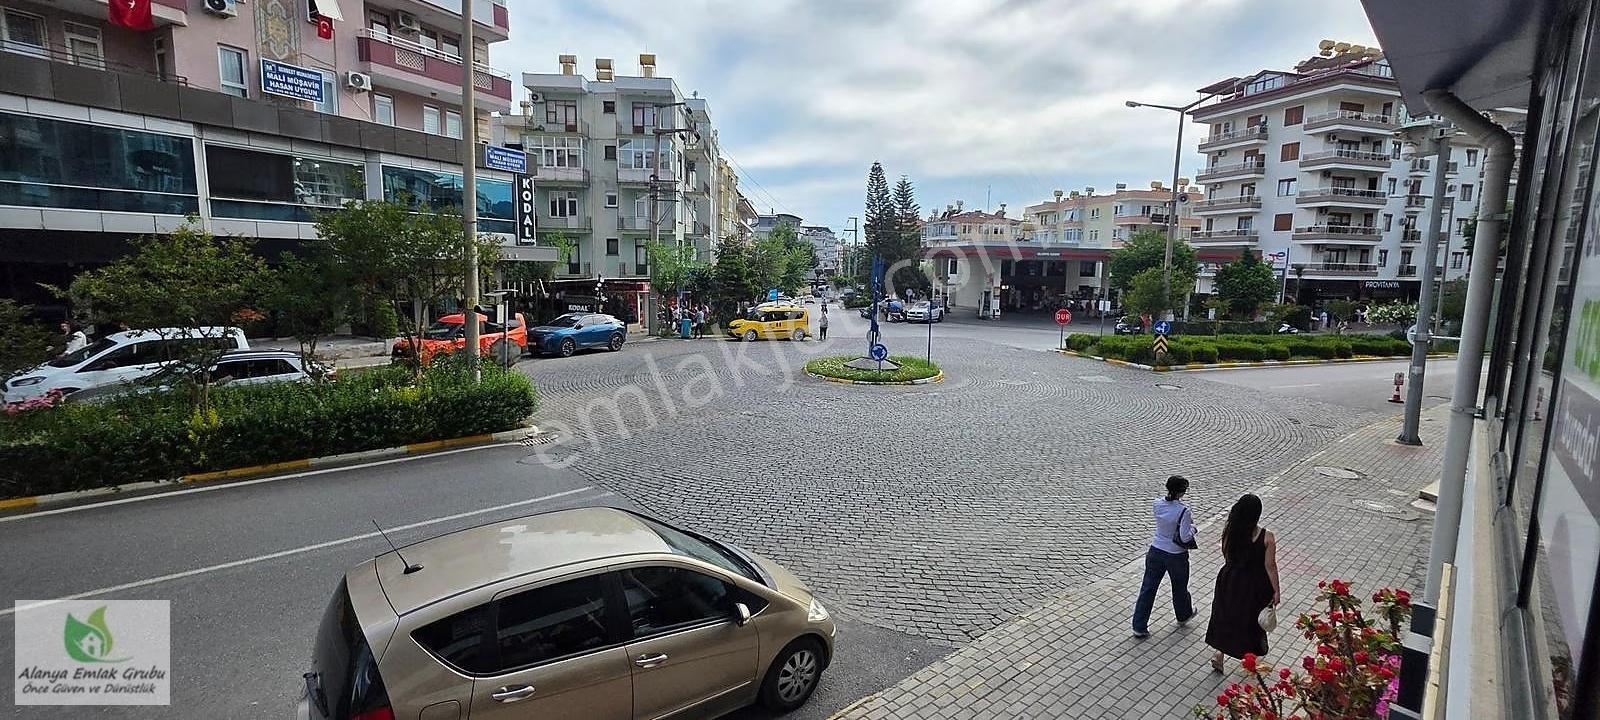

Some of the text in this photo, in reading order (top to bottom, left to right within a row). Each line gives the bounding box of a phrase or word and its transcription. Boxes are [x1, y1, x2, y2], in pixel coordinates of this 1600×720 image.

[269, 80, 294, 92] HASAN
[294, 86, 318, 97] UYGUN
[522, 178, 533, 238] KODAL
[568, 304, 588, 312] KODAL
